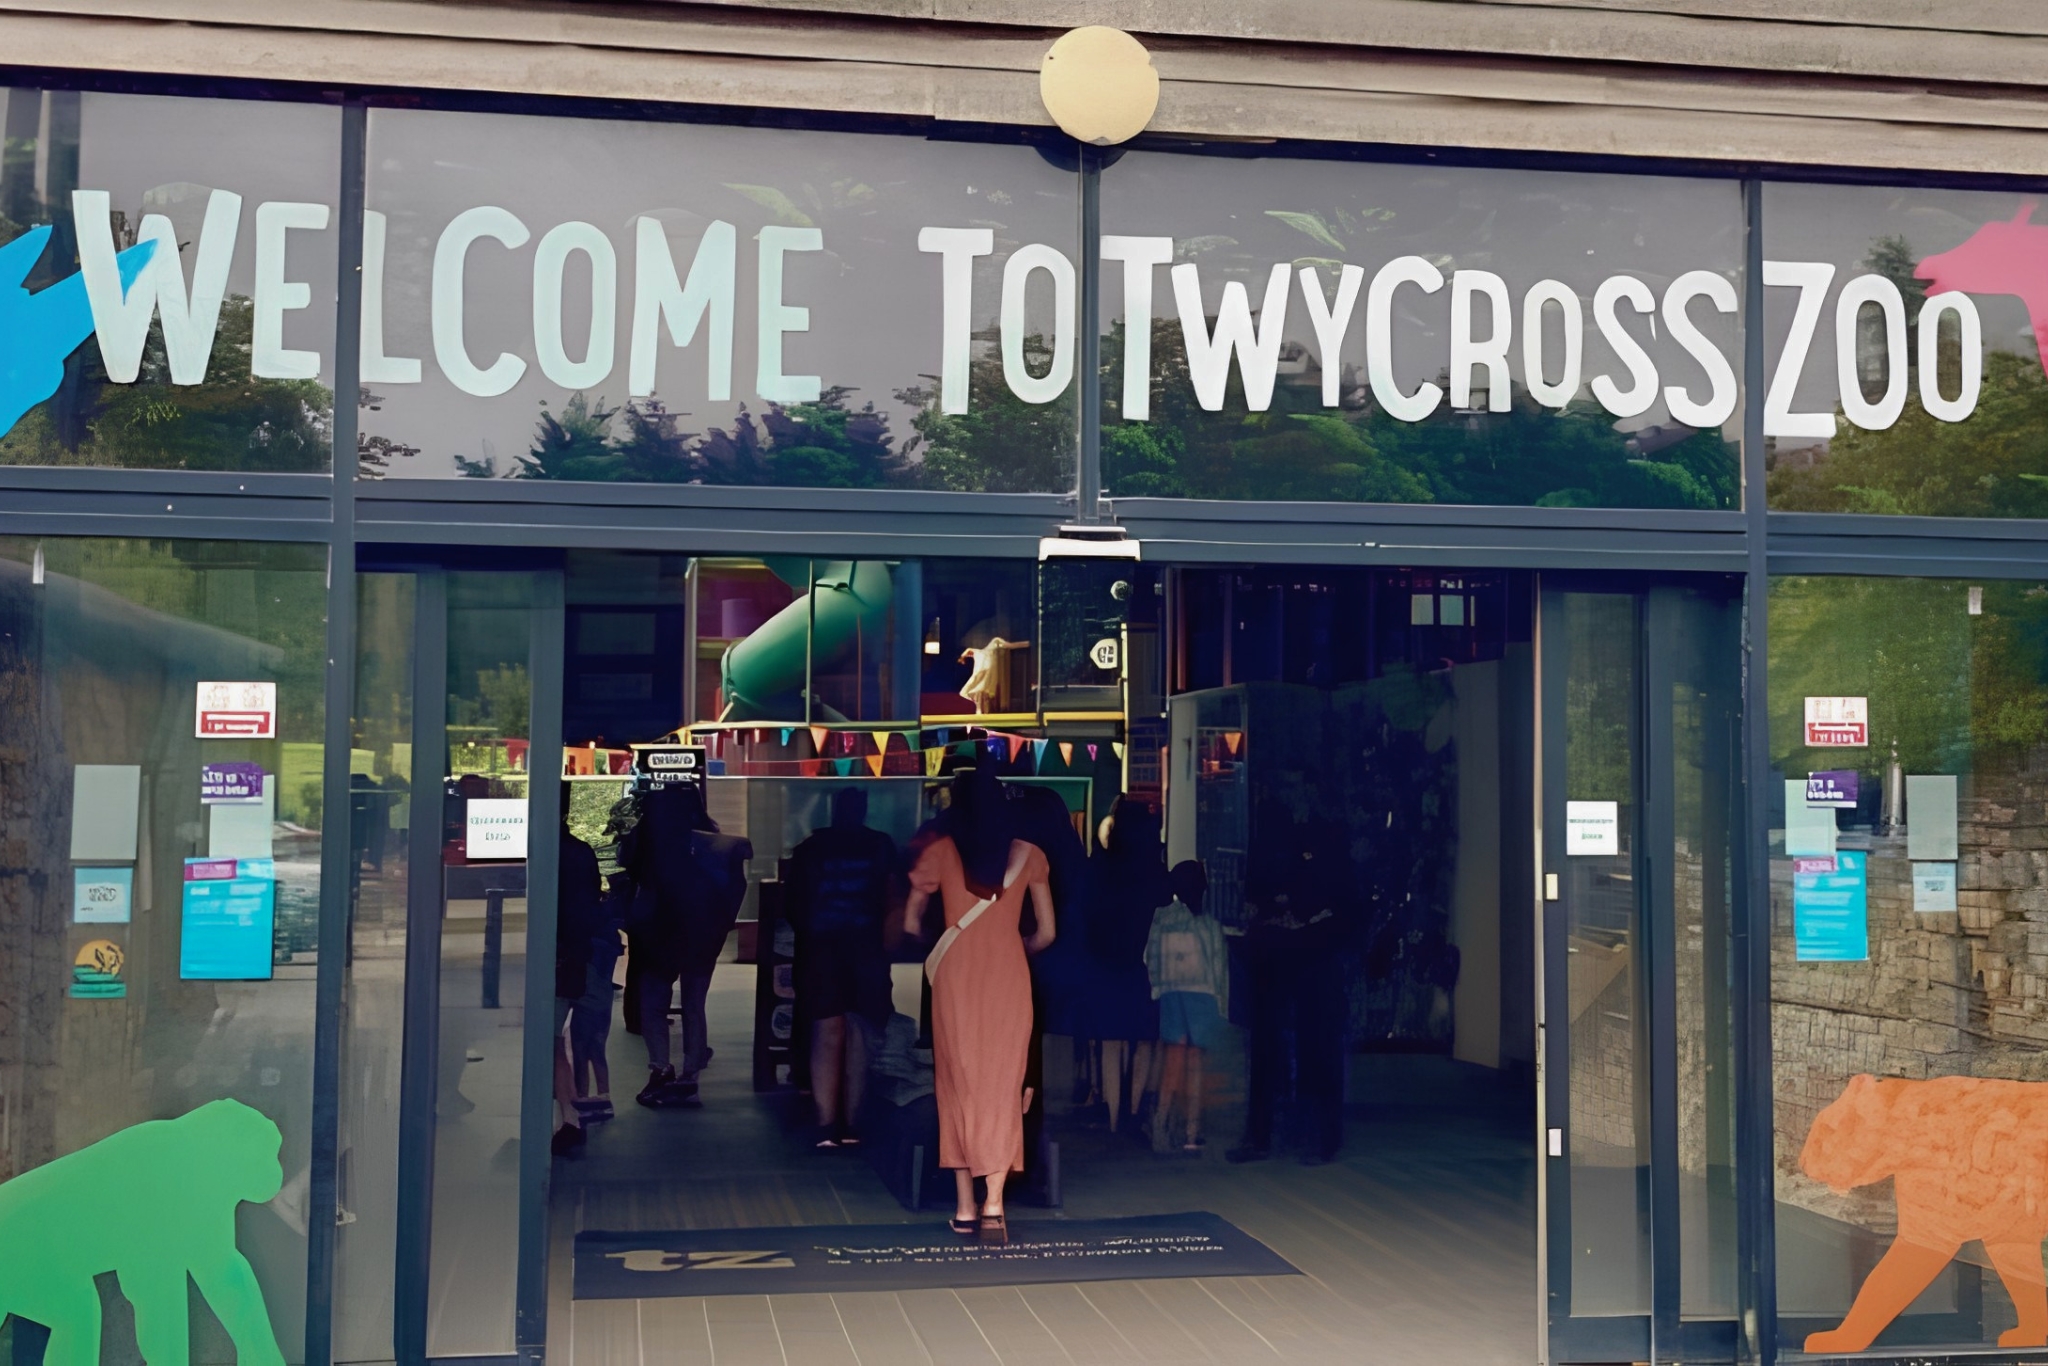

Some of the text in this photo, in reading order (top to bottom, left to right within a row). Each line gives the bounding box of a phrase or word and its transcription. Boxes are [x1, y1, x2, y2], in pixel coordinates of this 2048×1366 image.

[72, 189, 1983, 438] WELCOME TO TWYCROSS ZOO
